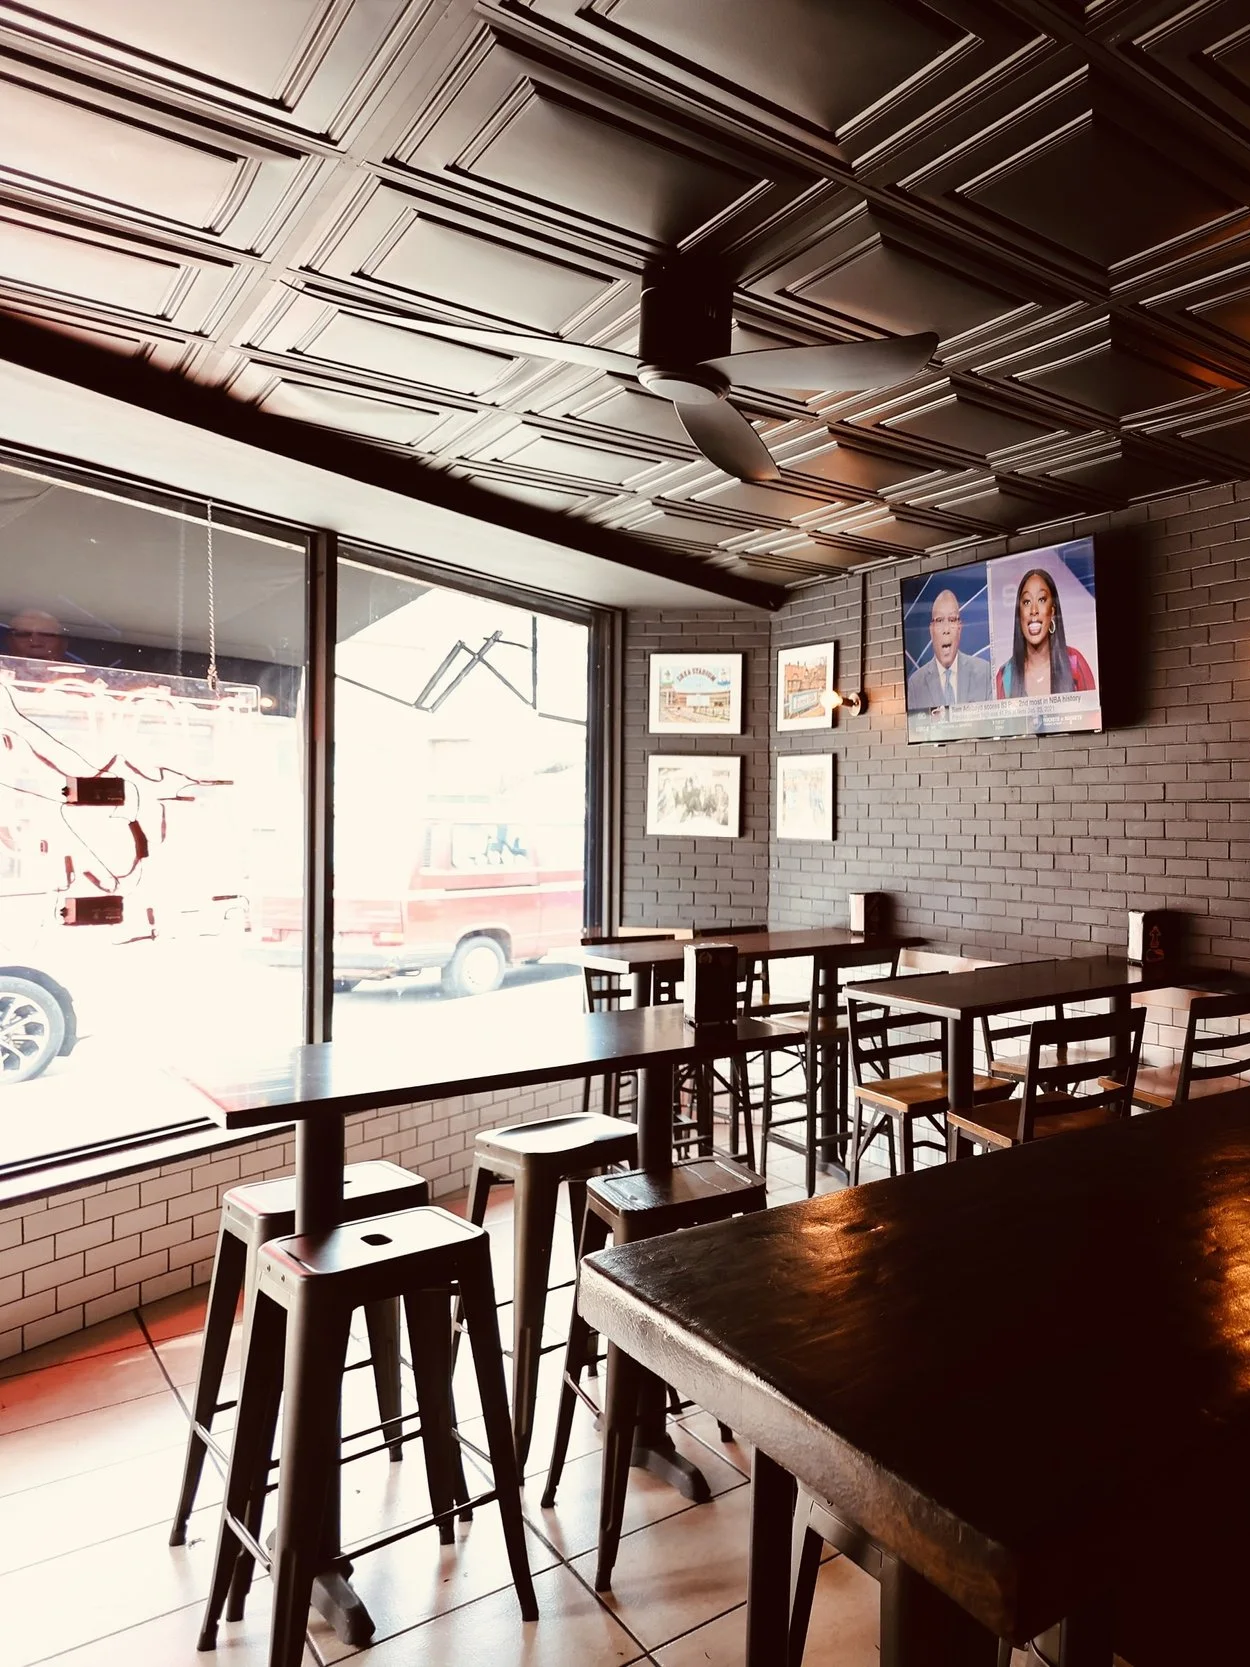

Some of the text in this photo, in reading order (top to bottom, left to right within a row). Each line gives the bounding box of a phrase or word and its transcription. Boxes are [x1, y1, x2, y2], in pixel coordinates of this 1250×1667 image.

[1029, 698, 1042, 706] most
[1049, 696, 1062, 704] NBA
[1062, 694, 1082, 704] history
